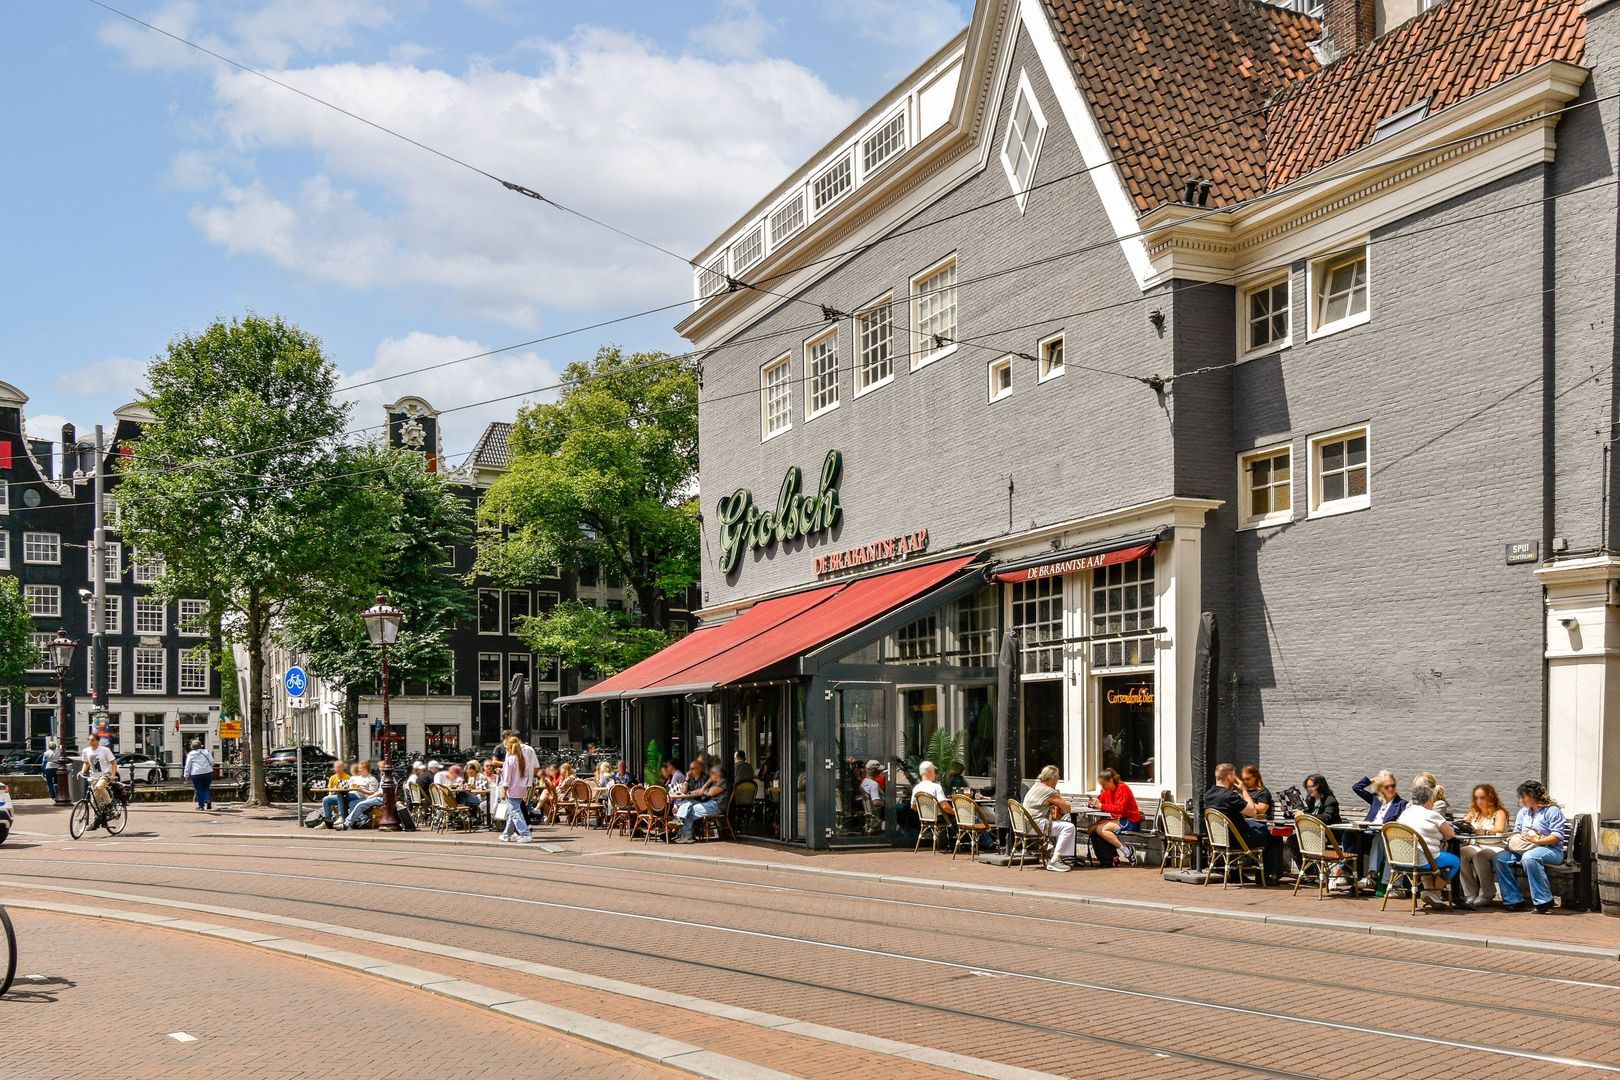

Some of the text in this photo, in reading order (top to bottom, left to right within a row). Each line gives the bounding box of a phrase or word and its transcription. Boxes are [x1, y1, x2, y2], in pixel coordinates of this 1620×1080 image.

[717, 449, 842, 574] Grolsch
[813, 527, 928, 576] DE BRABANTSE AAP
[1509, 553, 1533, 561] CENTRUM
[1512, 544, 1529, 553] SPUI
[1027, 553, 1106, 579] DE BRABANTSE AAP
